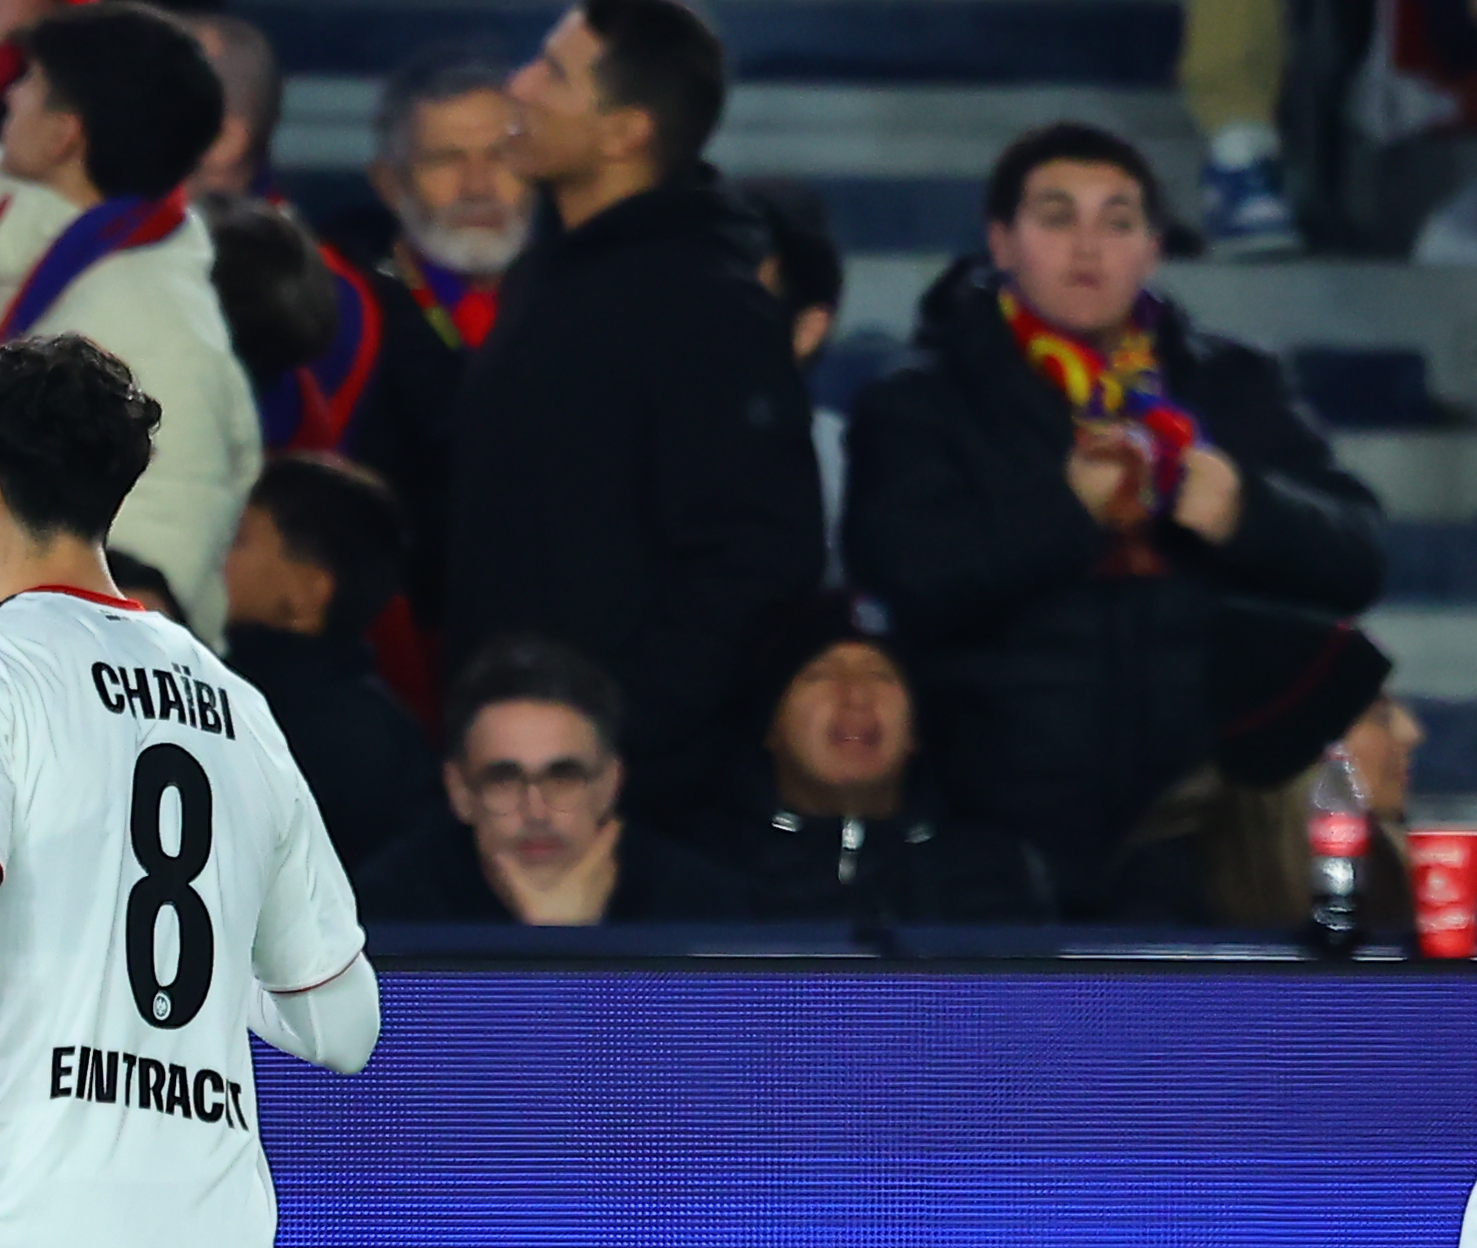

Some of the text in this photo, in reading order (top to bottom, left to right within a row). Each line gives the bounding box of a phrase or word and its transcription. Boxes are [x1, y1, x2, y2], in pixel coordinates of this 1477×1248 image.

[91, 661, 236, 740] CHAÏBI
[125, 742, 214, 1029] 8
[50, 1045, 249, 1132] EINTRACT
